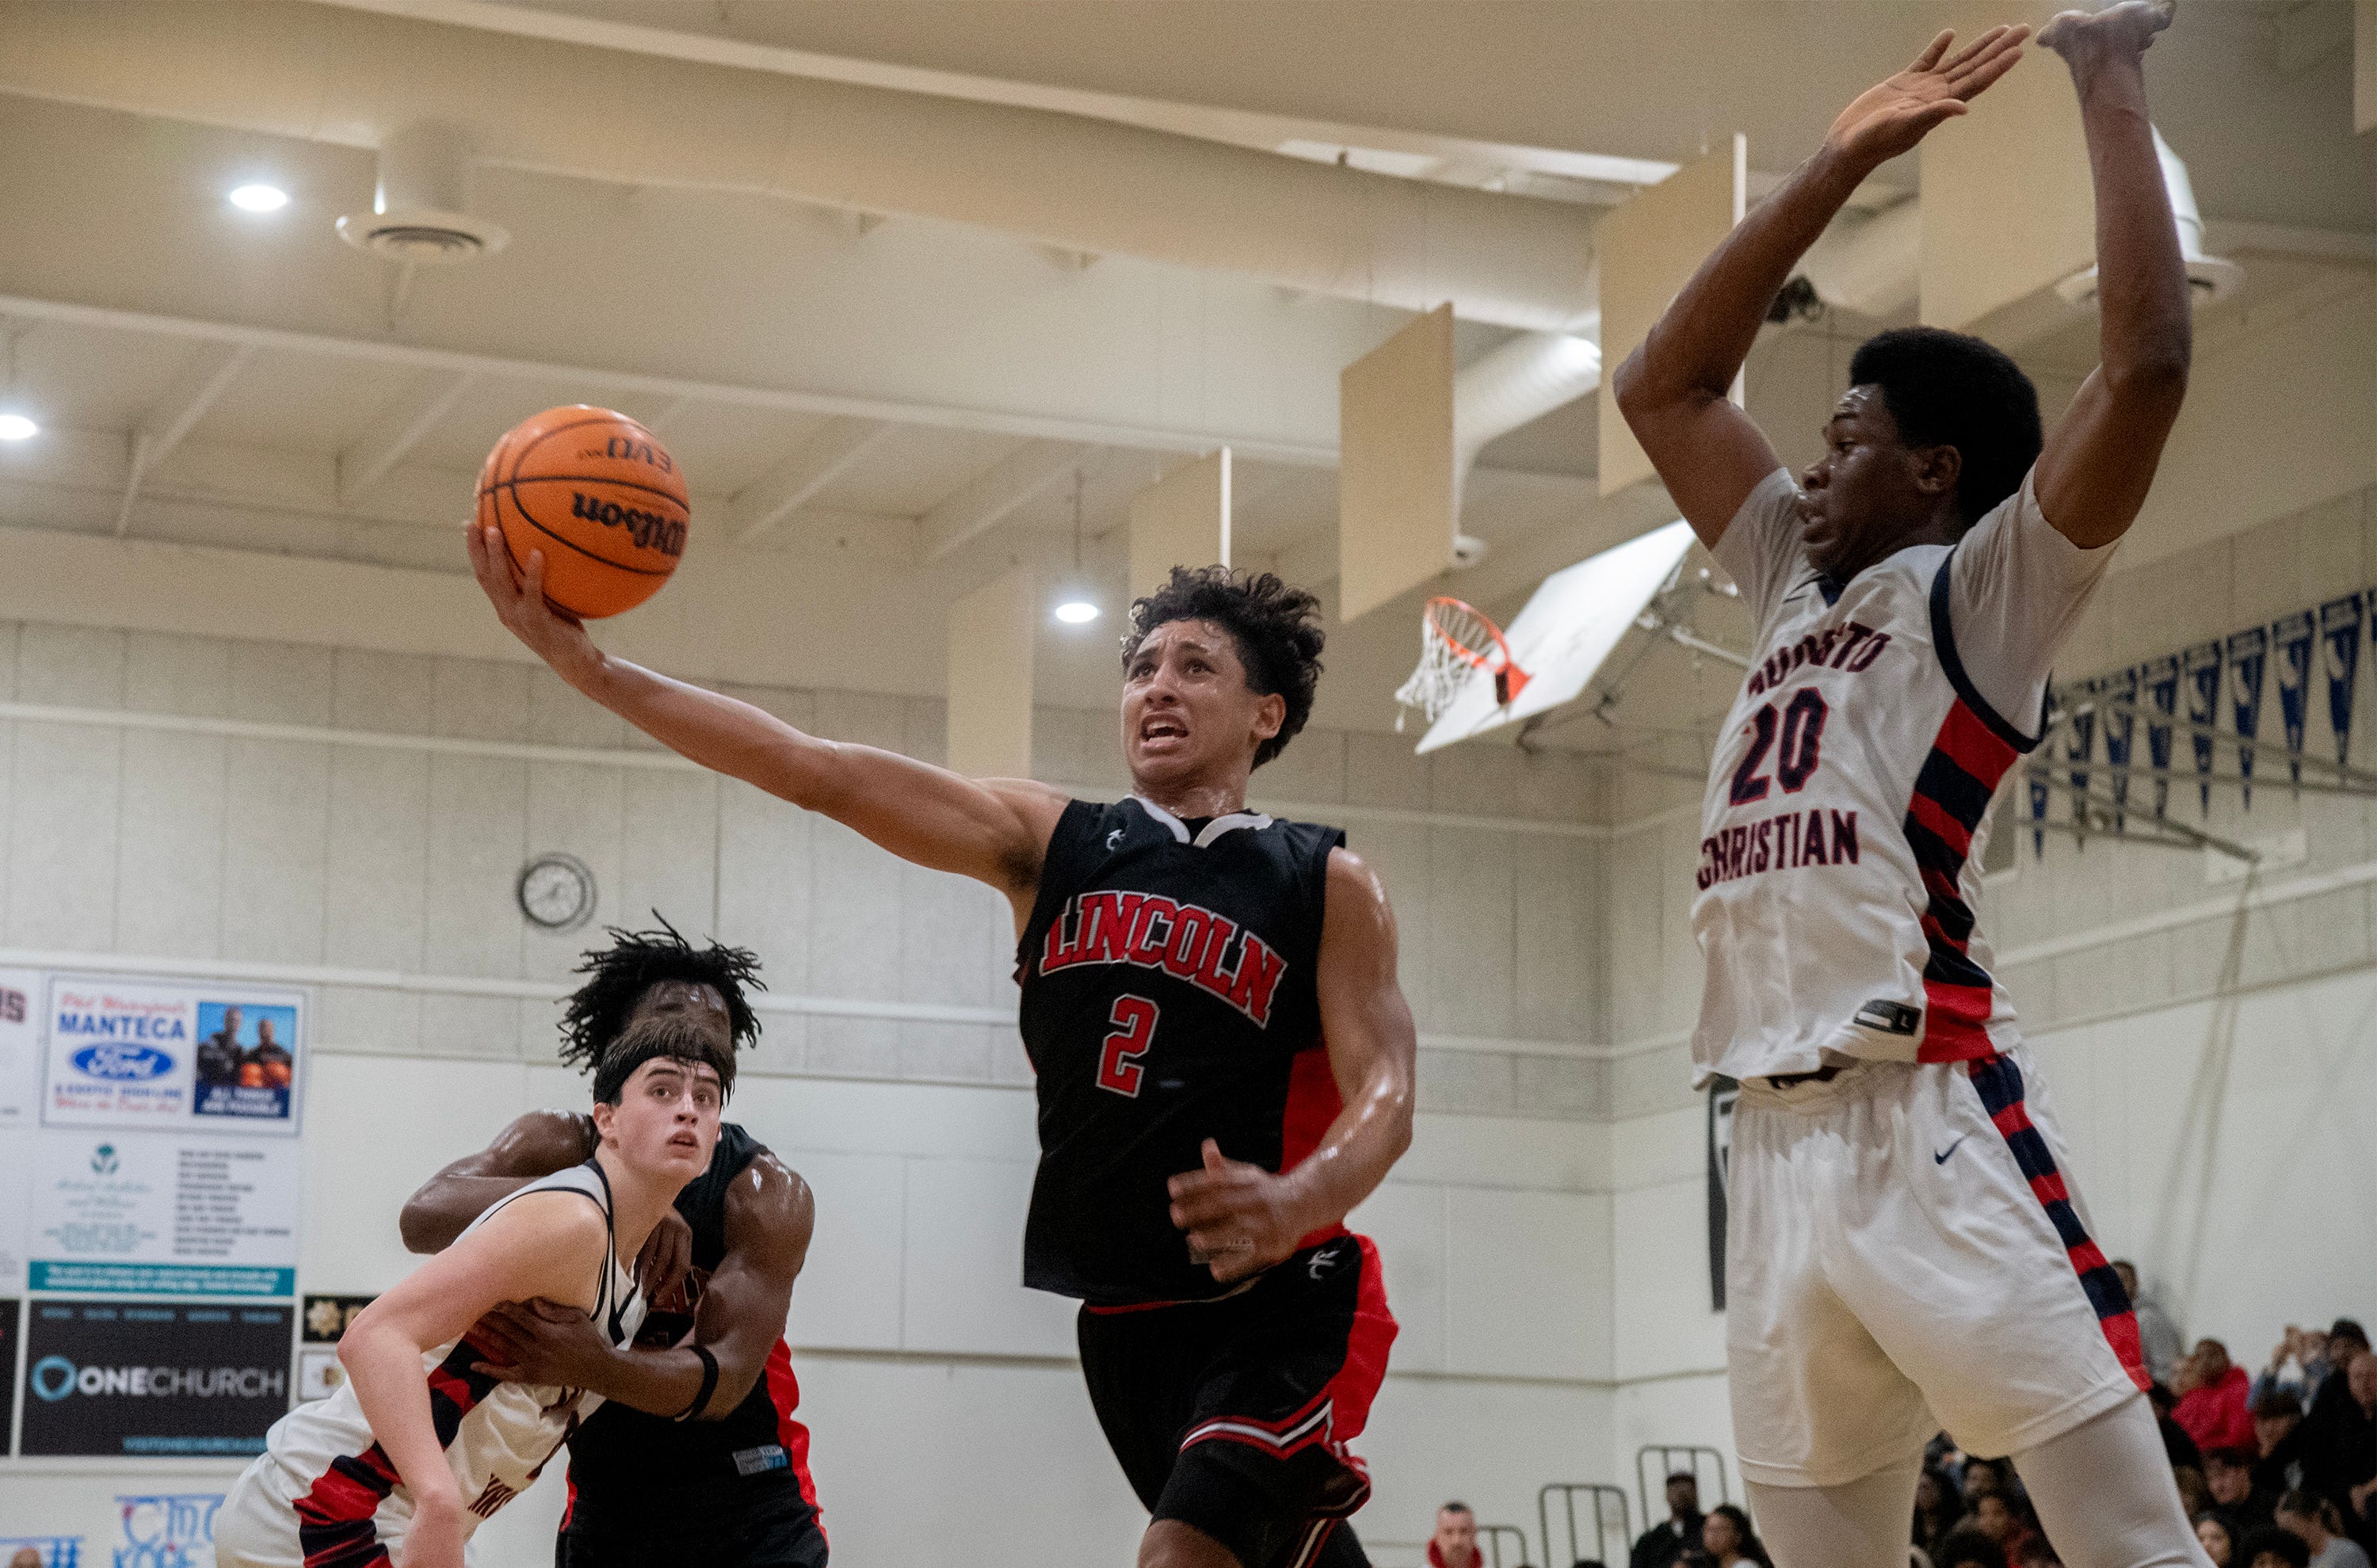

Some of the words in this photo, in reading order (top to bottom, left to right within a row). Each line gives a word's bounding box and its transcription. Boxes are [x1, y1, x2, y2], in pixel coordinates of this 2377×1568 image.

[572, 491, 686, 558] Wilson
[1729, 686, 1829, 807] 20
[1696, 808, 1860, 891] CHRISTIAN
[1039, 890, 1288, 1030] LINCOLN
[57, 1013, 187, 1040] MANTECA
[1095, 992, 1160, 1099] 2
